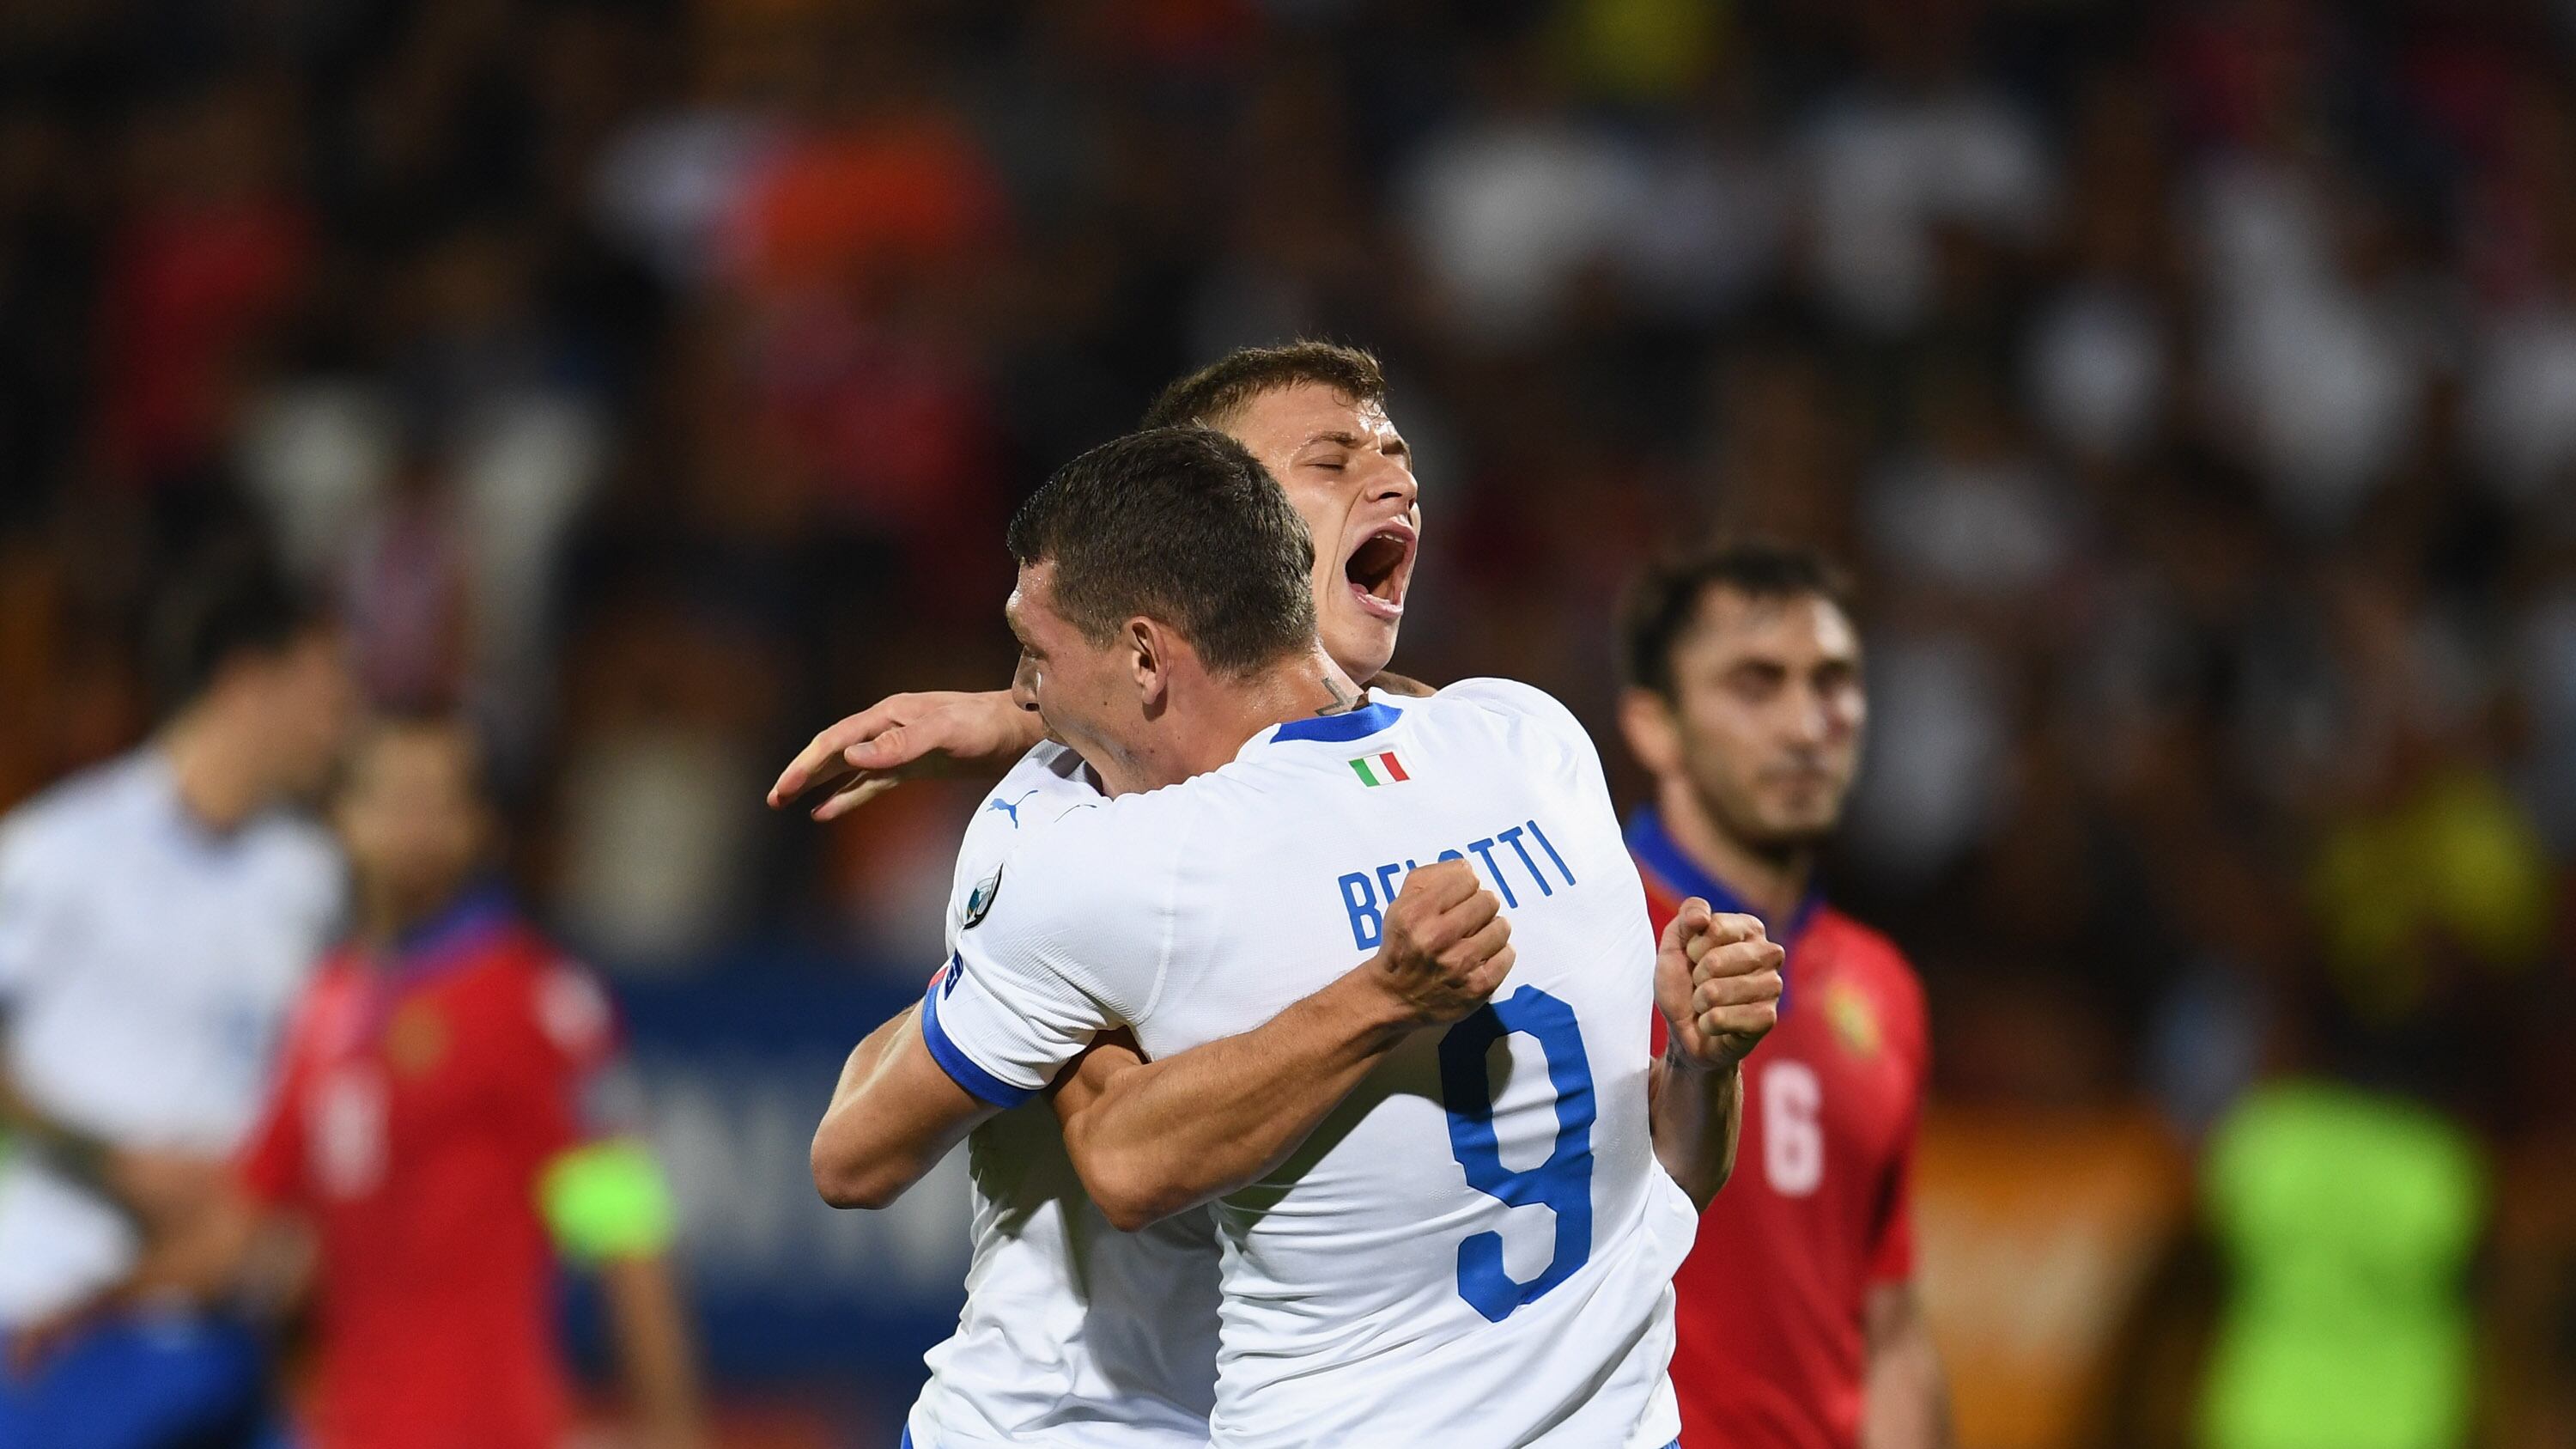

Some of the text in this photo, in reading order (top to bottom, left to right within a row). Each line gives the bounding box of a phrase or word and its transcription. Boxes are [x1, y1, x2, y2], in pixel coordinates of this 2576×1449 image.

[1338, 819, 1577, 951] BTTI
[1438, 983, 1596, 1323] 9
[1762, 1059, 1824, 1194] 6
